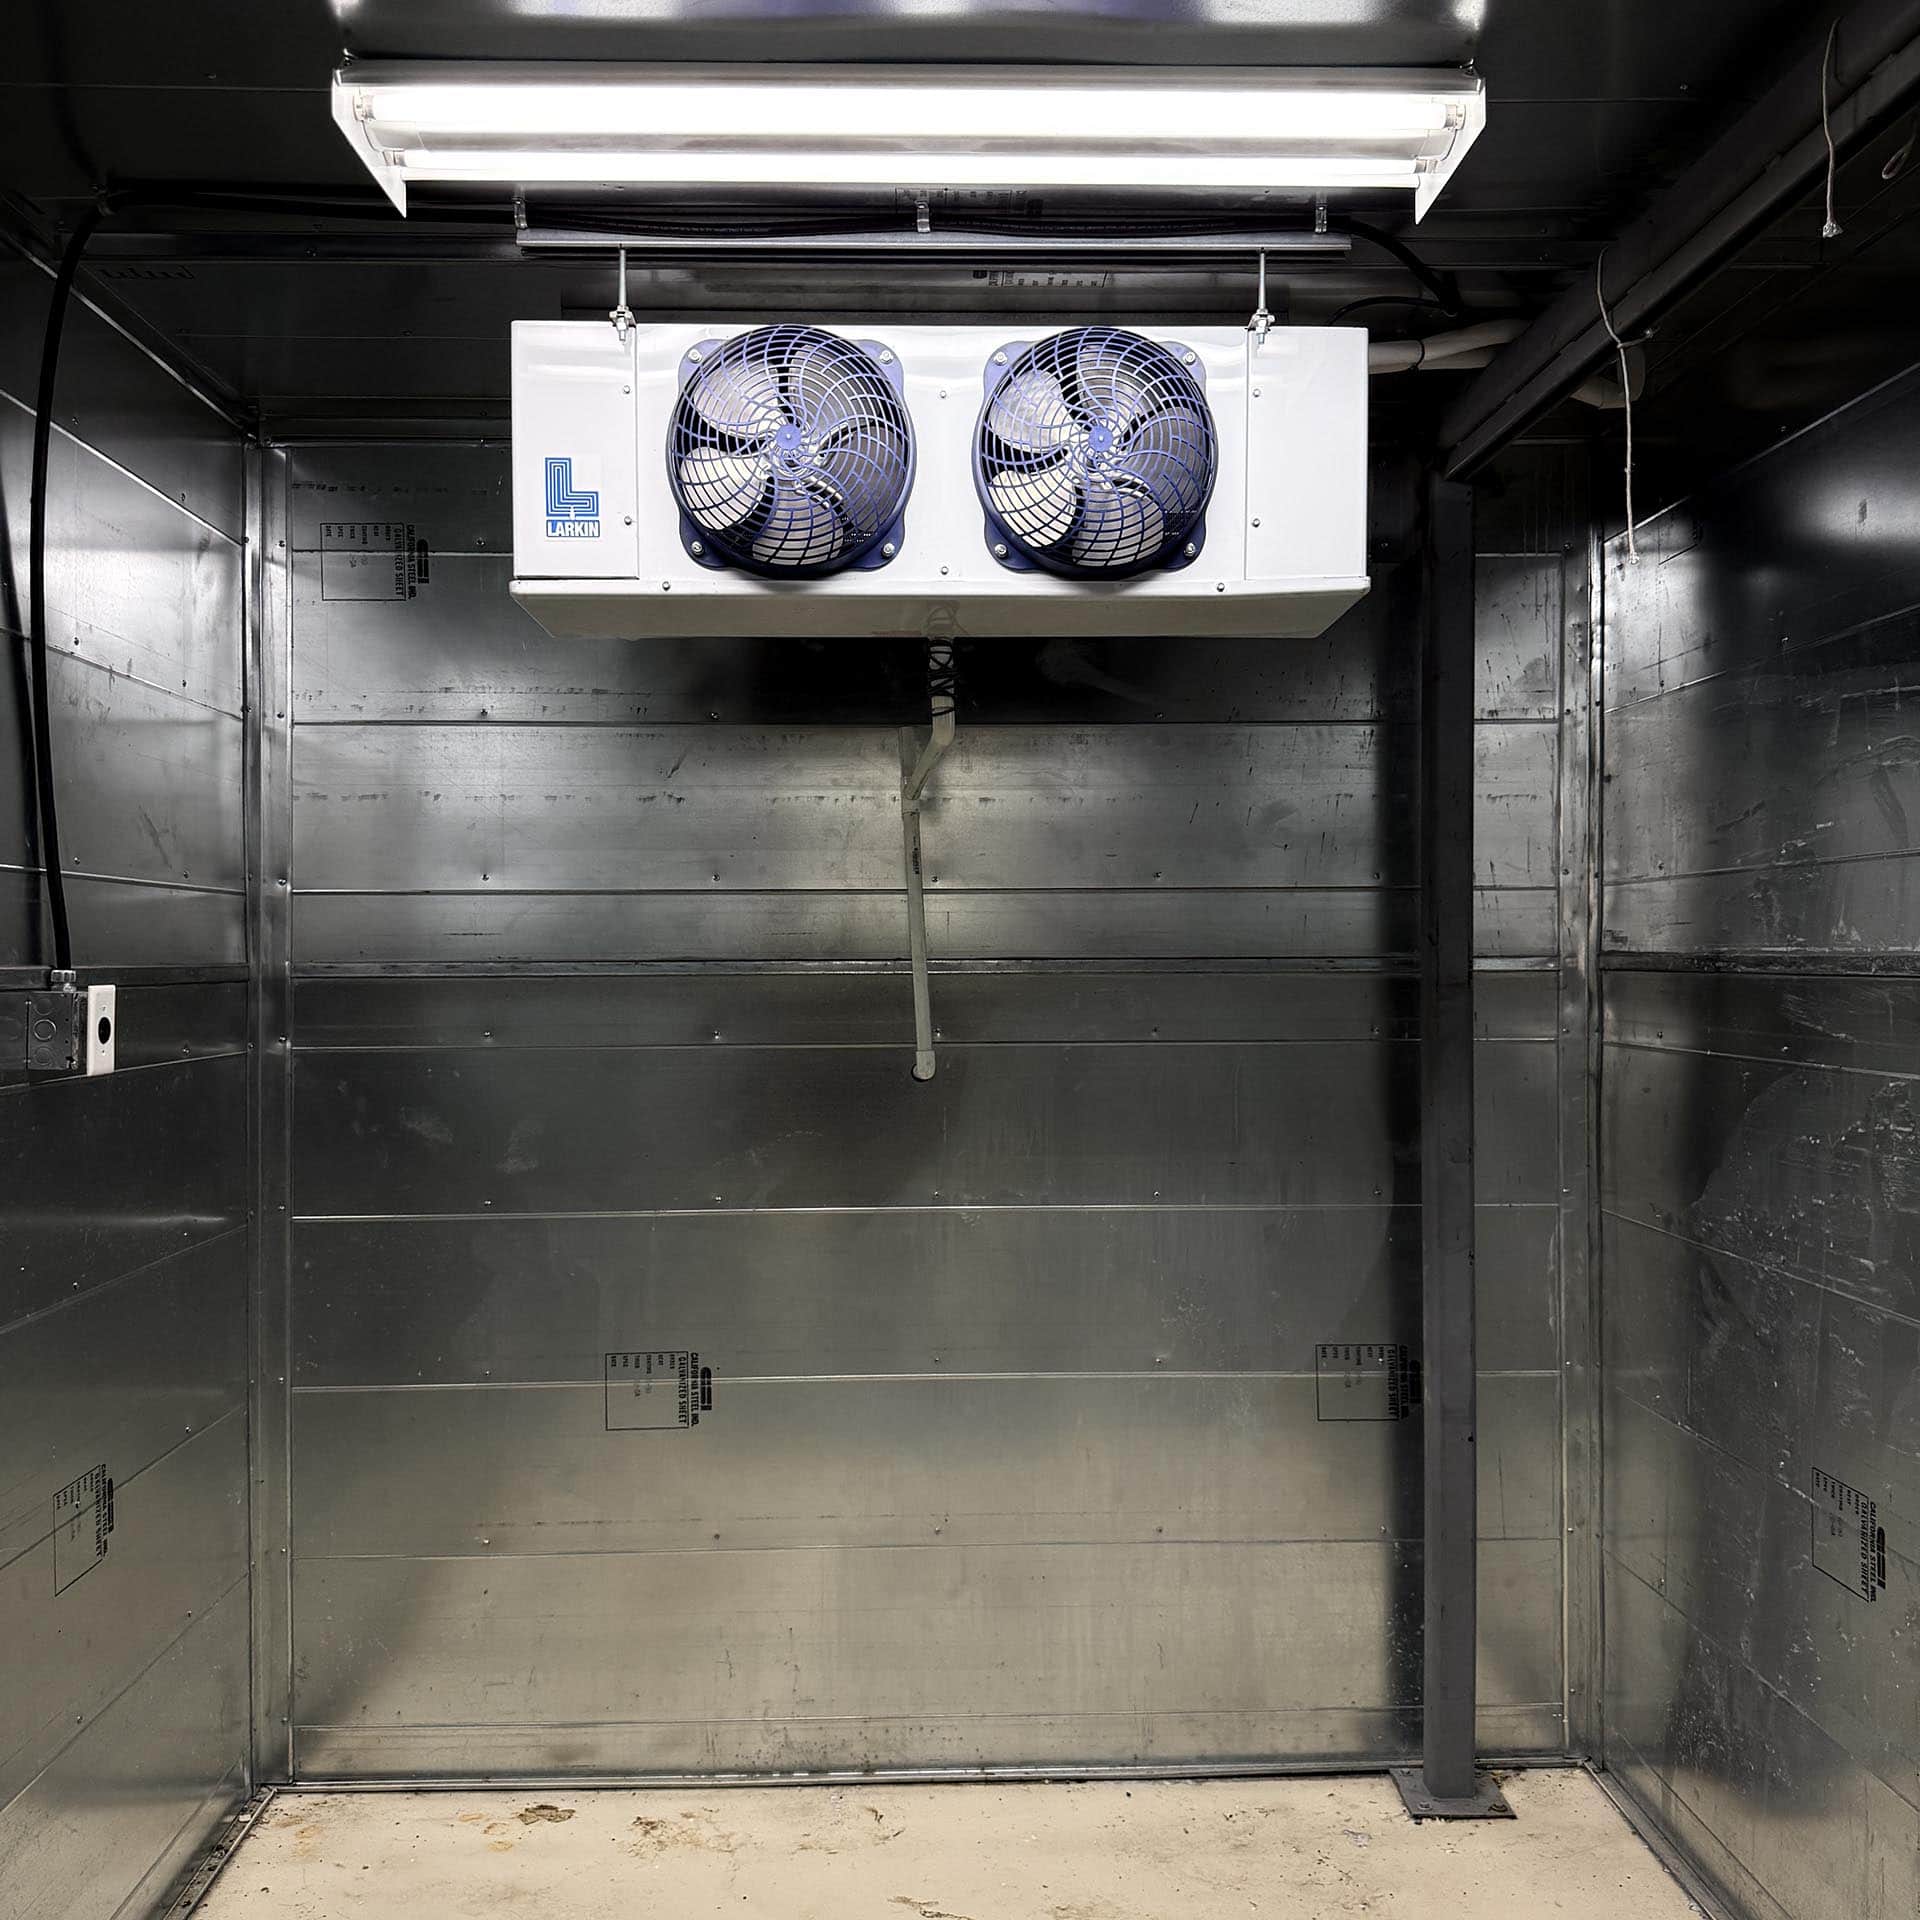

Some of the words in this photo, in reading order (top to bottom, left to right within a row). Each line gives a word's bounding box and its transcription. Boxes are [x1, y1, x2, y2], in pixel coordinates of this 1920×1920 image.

[547, 520, 600, 537] LARKIN
[394, 528, 403, 571] GALVAIZED
[395, 574, 404, 596] SHEET
[408, 564, 416, 584] STEEL
[679, 1401, 687, 1424] SHEET
[691, 1391, 699, 1412] STEEL
[1860, 1502, 1868, 1560] GALVANIZED
